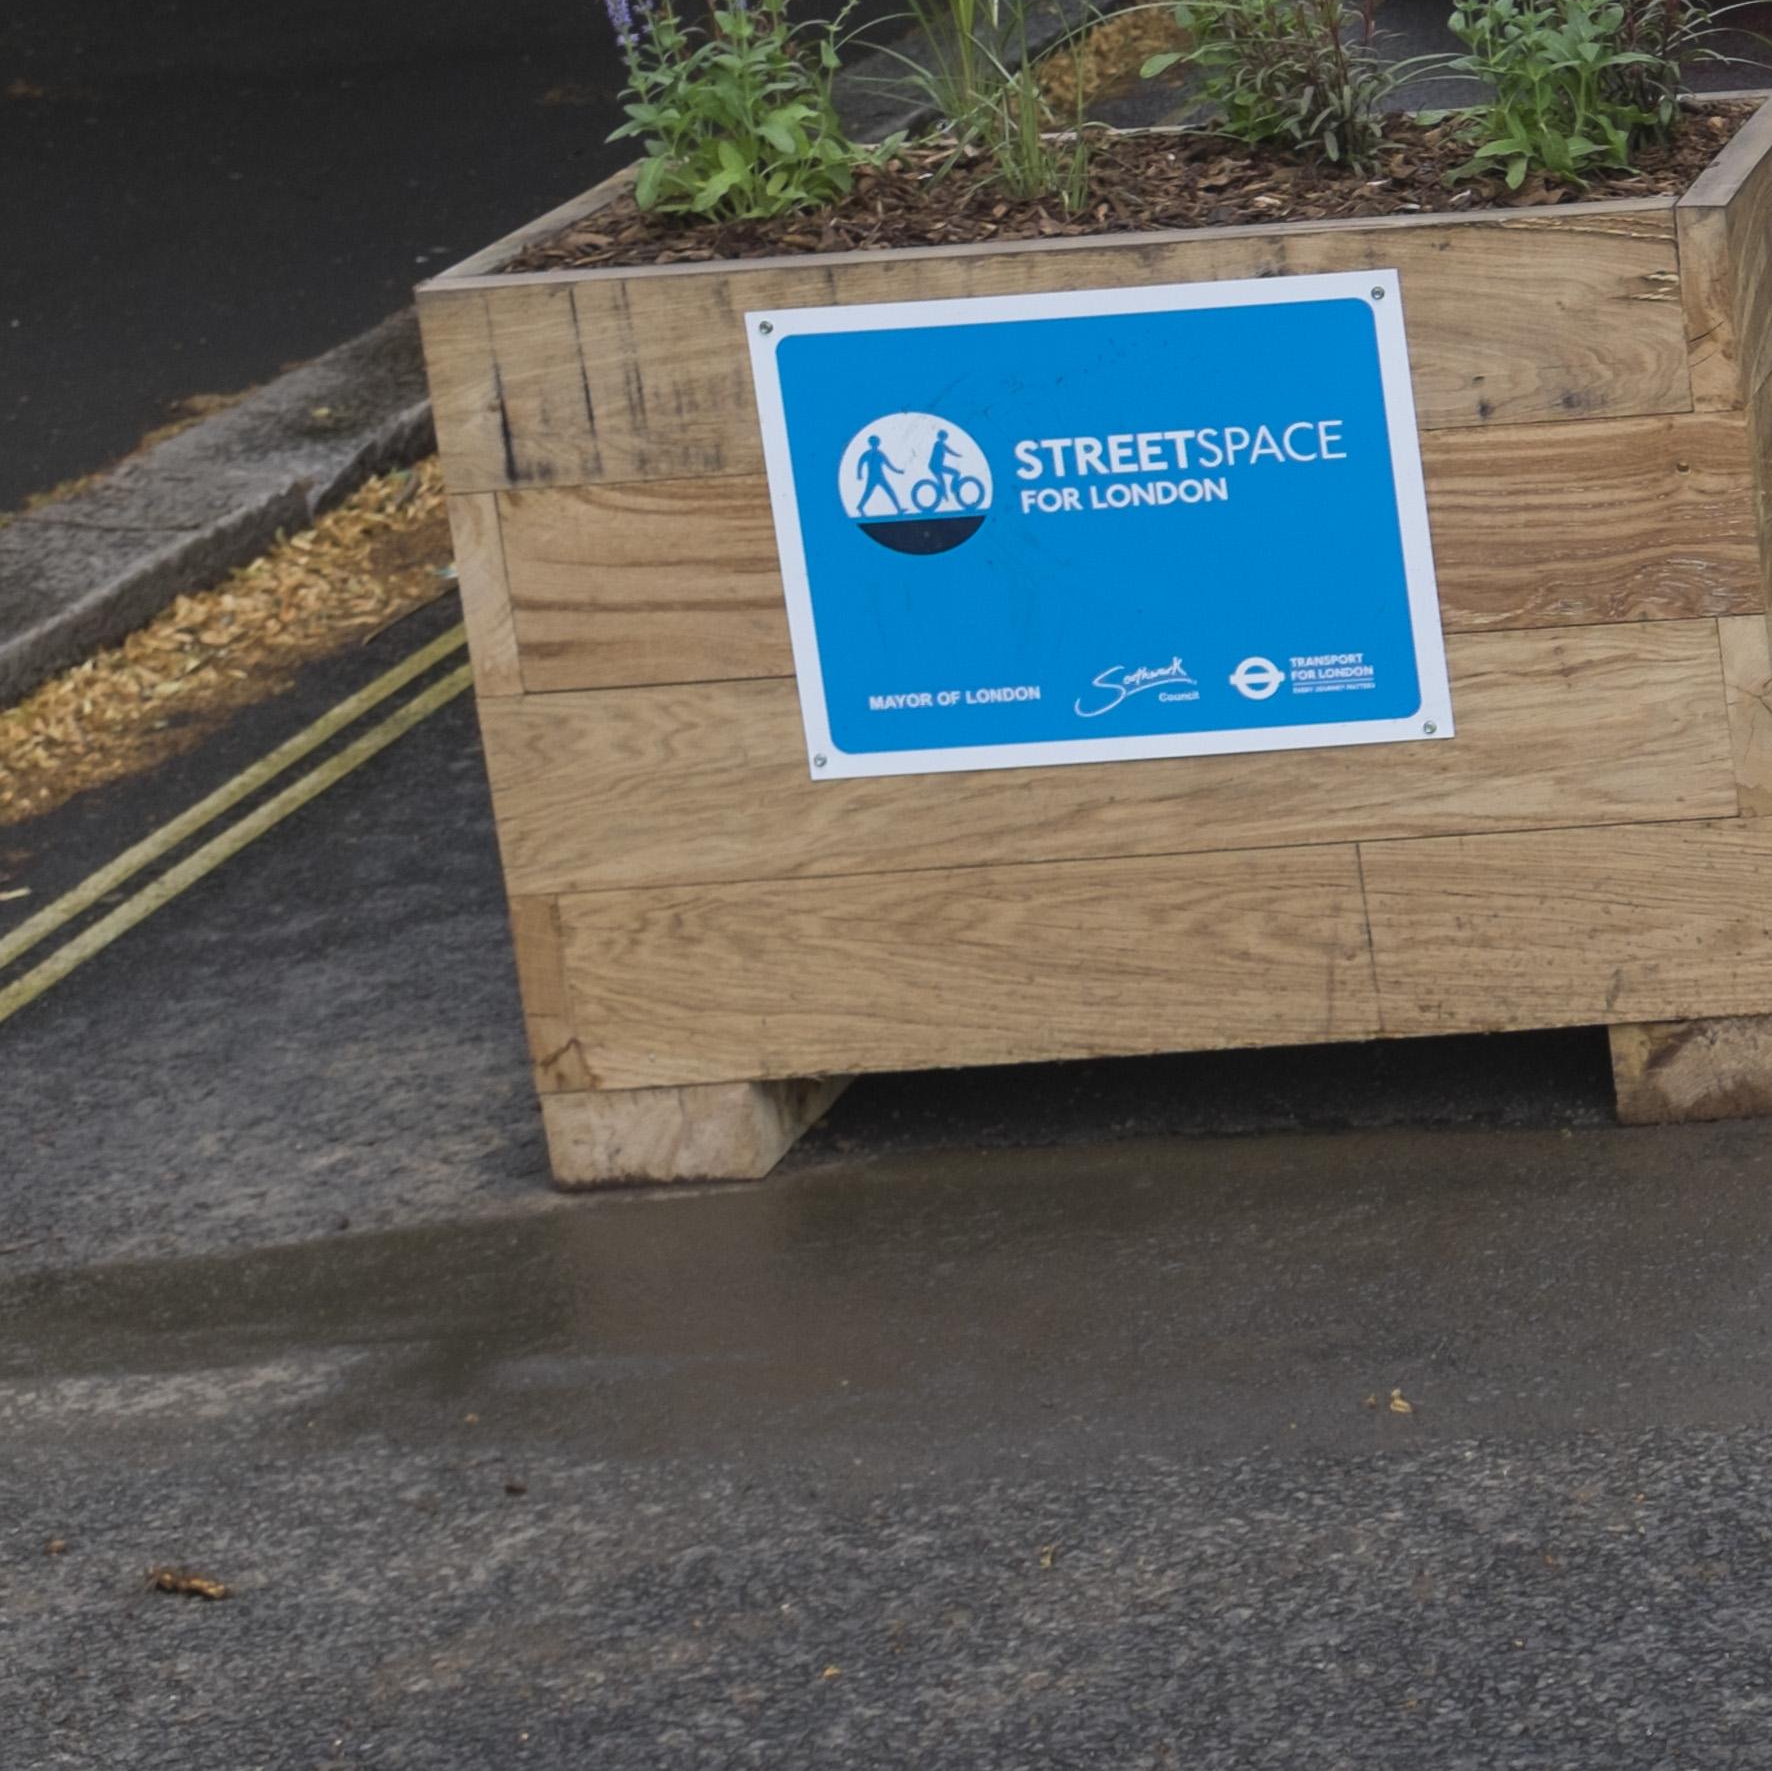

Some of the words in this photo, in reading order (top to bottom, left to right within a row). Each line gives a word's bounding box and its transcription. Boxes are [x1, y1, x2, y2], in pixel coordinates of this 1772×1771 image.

[1014, 419, 1347, 481] STREETSPACE
[1020, 486, 1083, 515] FOR
[1089, 477, 1229, 511] LONDON
[1289, 652, 1364, 668] TRANSPORT
[1291, 669, 1317, 681] FOR
[1318, 664, 1375, 679] LONDON
[868, 692, 933, 710] MAYOR
[936, 690, 961, 706] OF
[965, 685, 1041, 704] LONDON
[1158, 691, 1200, 703] Council
